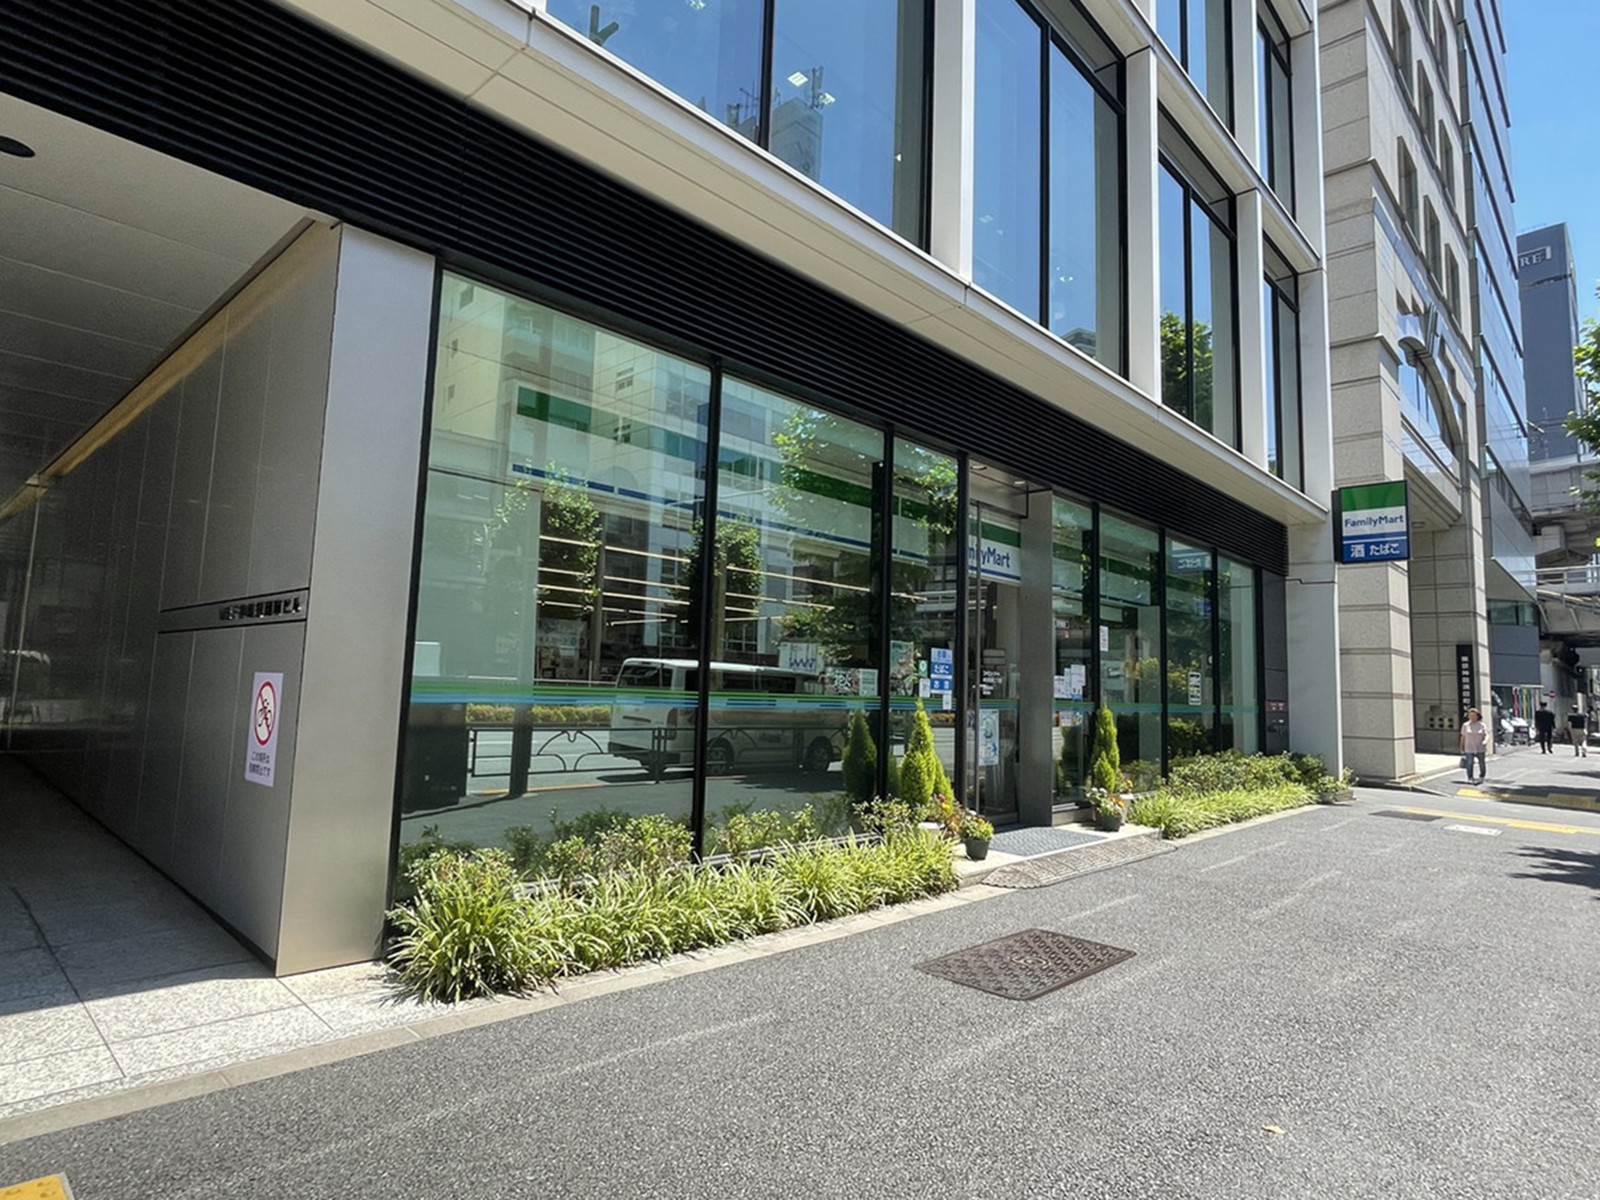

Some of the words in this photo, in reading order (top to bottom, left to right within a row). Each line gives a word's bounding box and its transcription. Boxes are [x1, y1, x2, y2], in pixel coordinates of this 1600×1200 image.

[1344, 514, 1404, 527] FamilyMart
[968, 546, 1011, 568] myMart
[1350, 544, 1365, 558] 酒
[1369, 543, 1400, 556] たばこ
